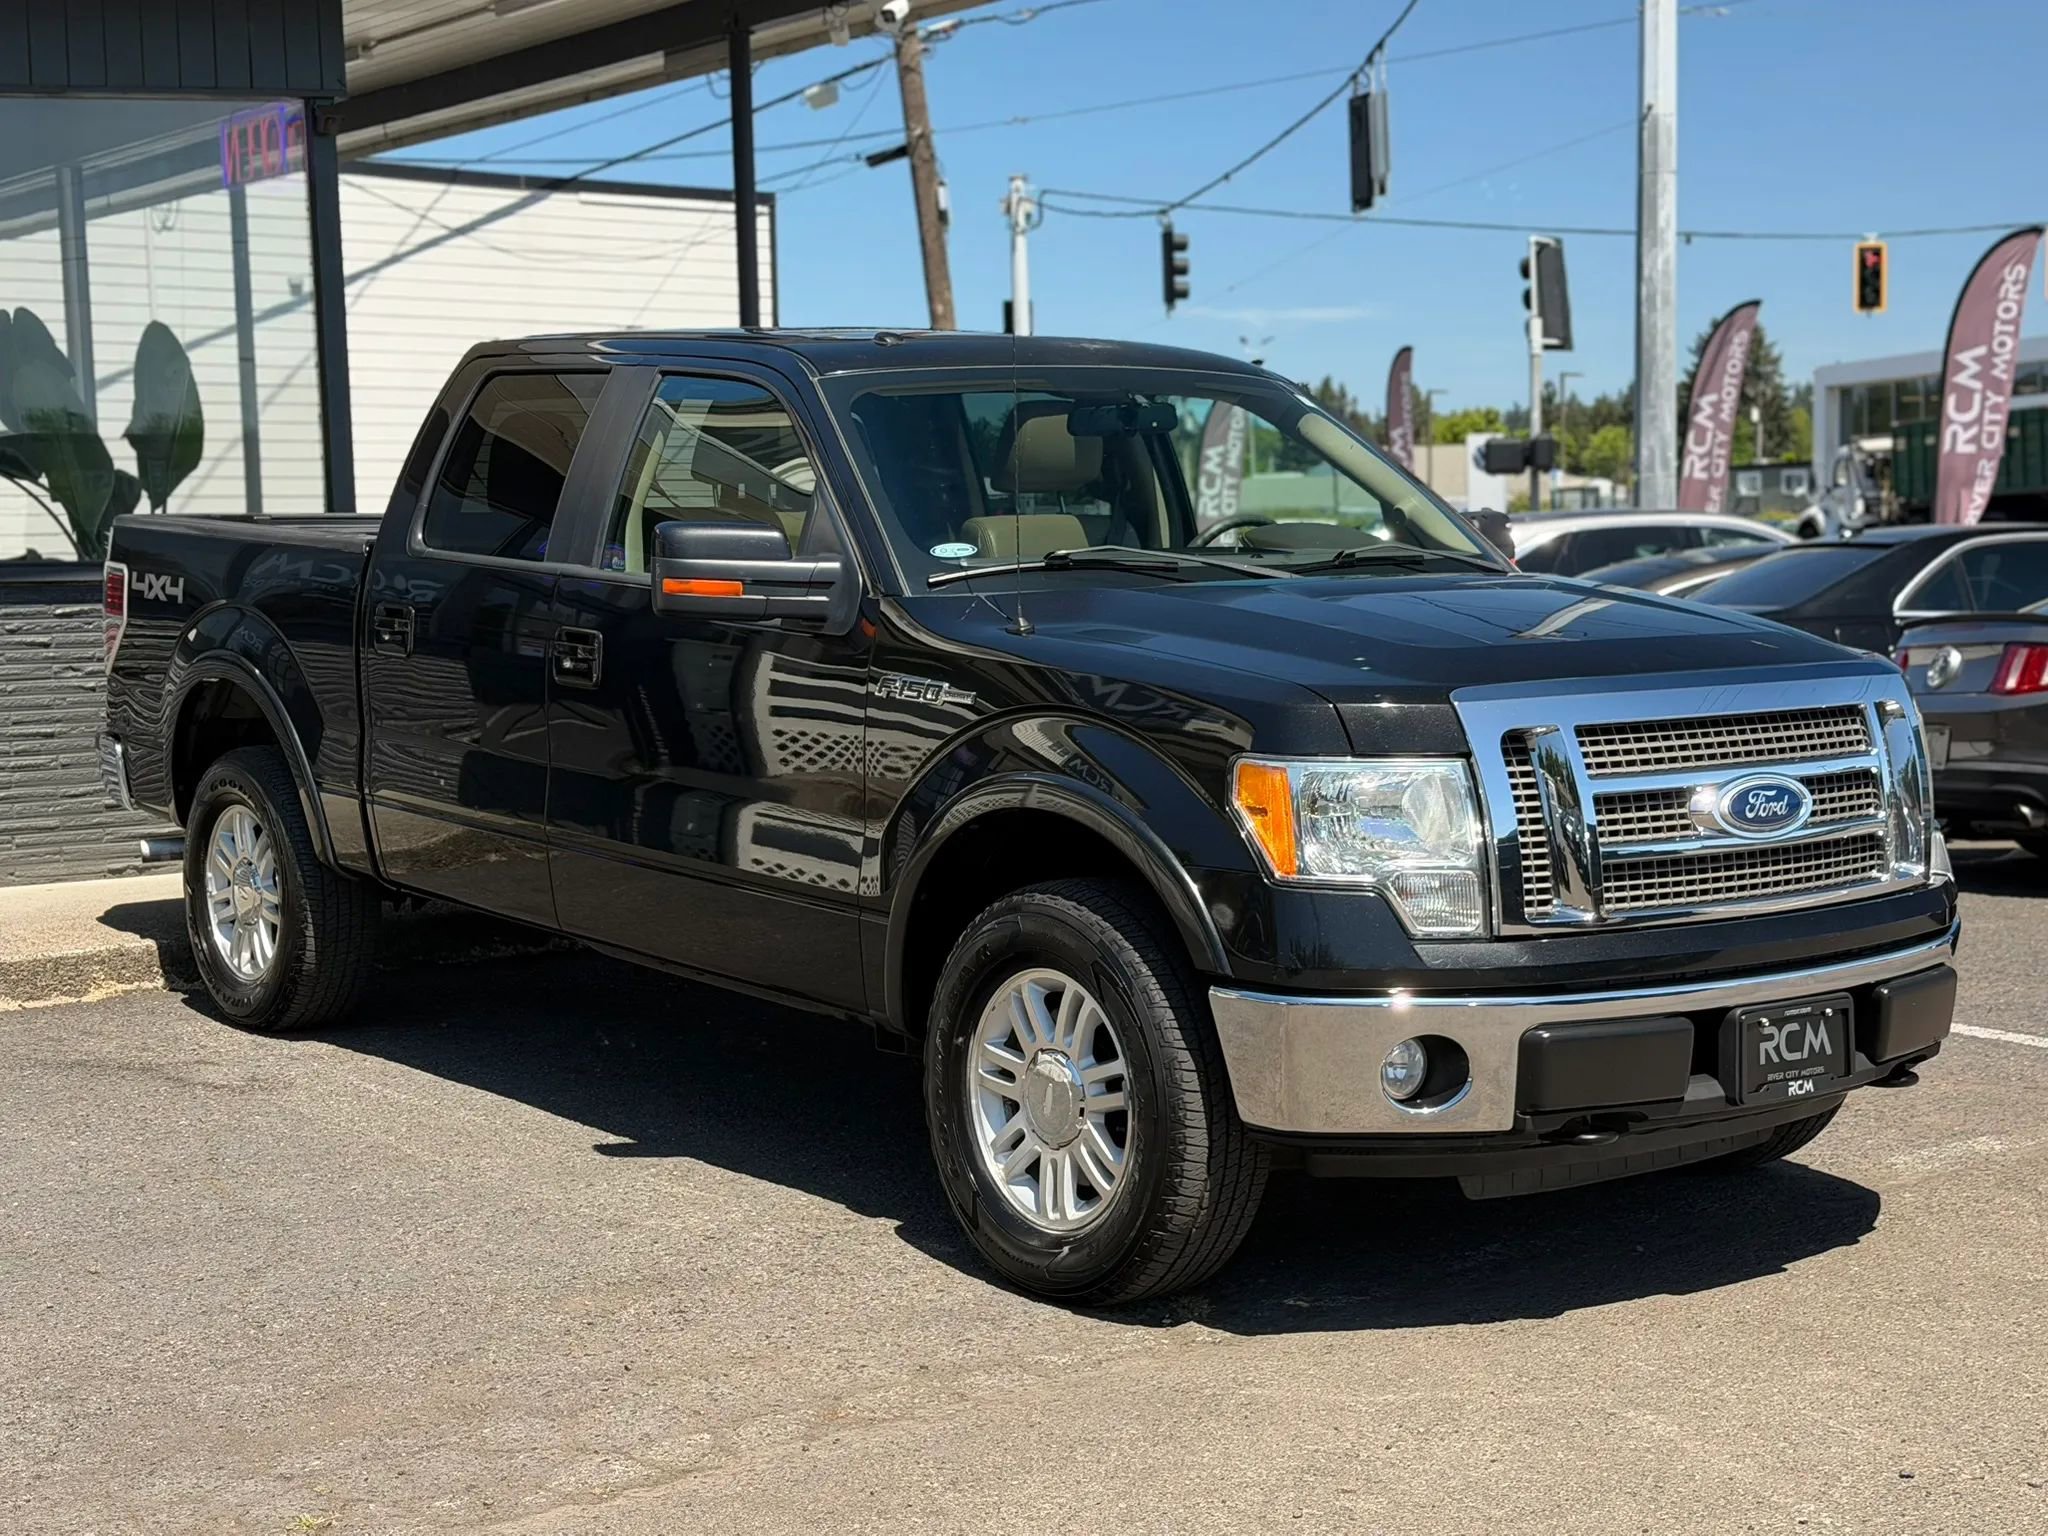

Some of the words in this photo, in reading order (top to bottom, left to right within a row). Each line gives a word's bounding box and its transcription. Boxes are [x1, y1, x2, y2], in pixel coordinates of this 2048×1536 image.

[1989, 262, 2027, 381] MOTORS
[1719, 328, 1750, 423] MOTORS
[1943, 345, 1989, 455] RCM
[1684, 393, 1720, 480] RCM
[1981, 390, 2006, 450] CITY
[1197, 445, 1224, 517] RCM
[1710, 429, 1730, 479] CITY
[131, 571, 185, 604] 4X4
[1745, 789, 1789, 819] Ford
[1760, 1019, 1832, 1065] RCM
[1767, 1071, 1784, 1082] RIVER
[1785, 1069, 1800, 1079] CITY
[1800, 1066, 1825, 1077] MOTORS
[1788, 1079, 1814, 1097] RCM
